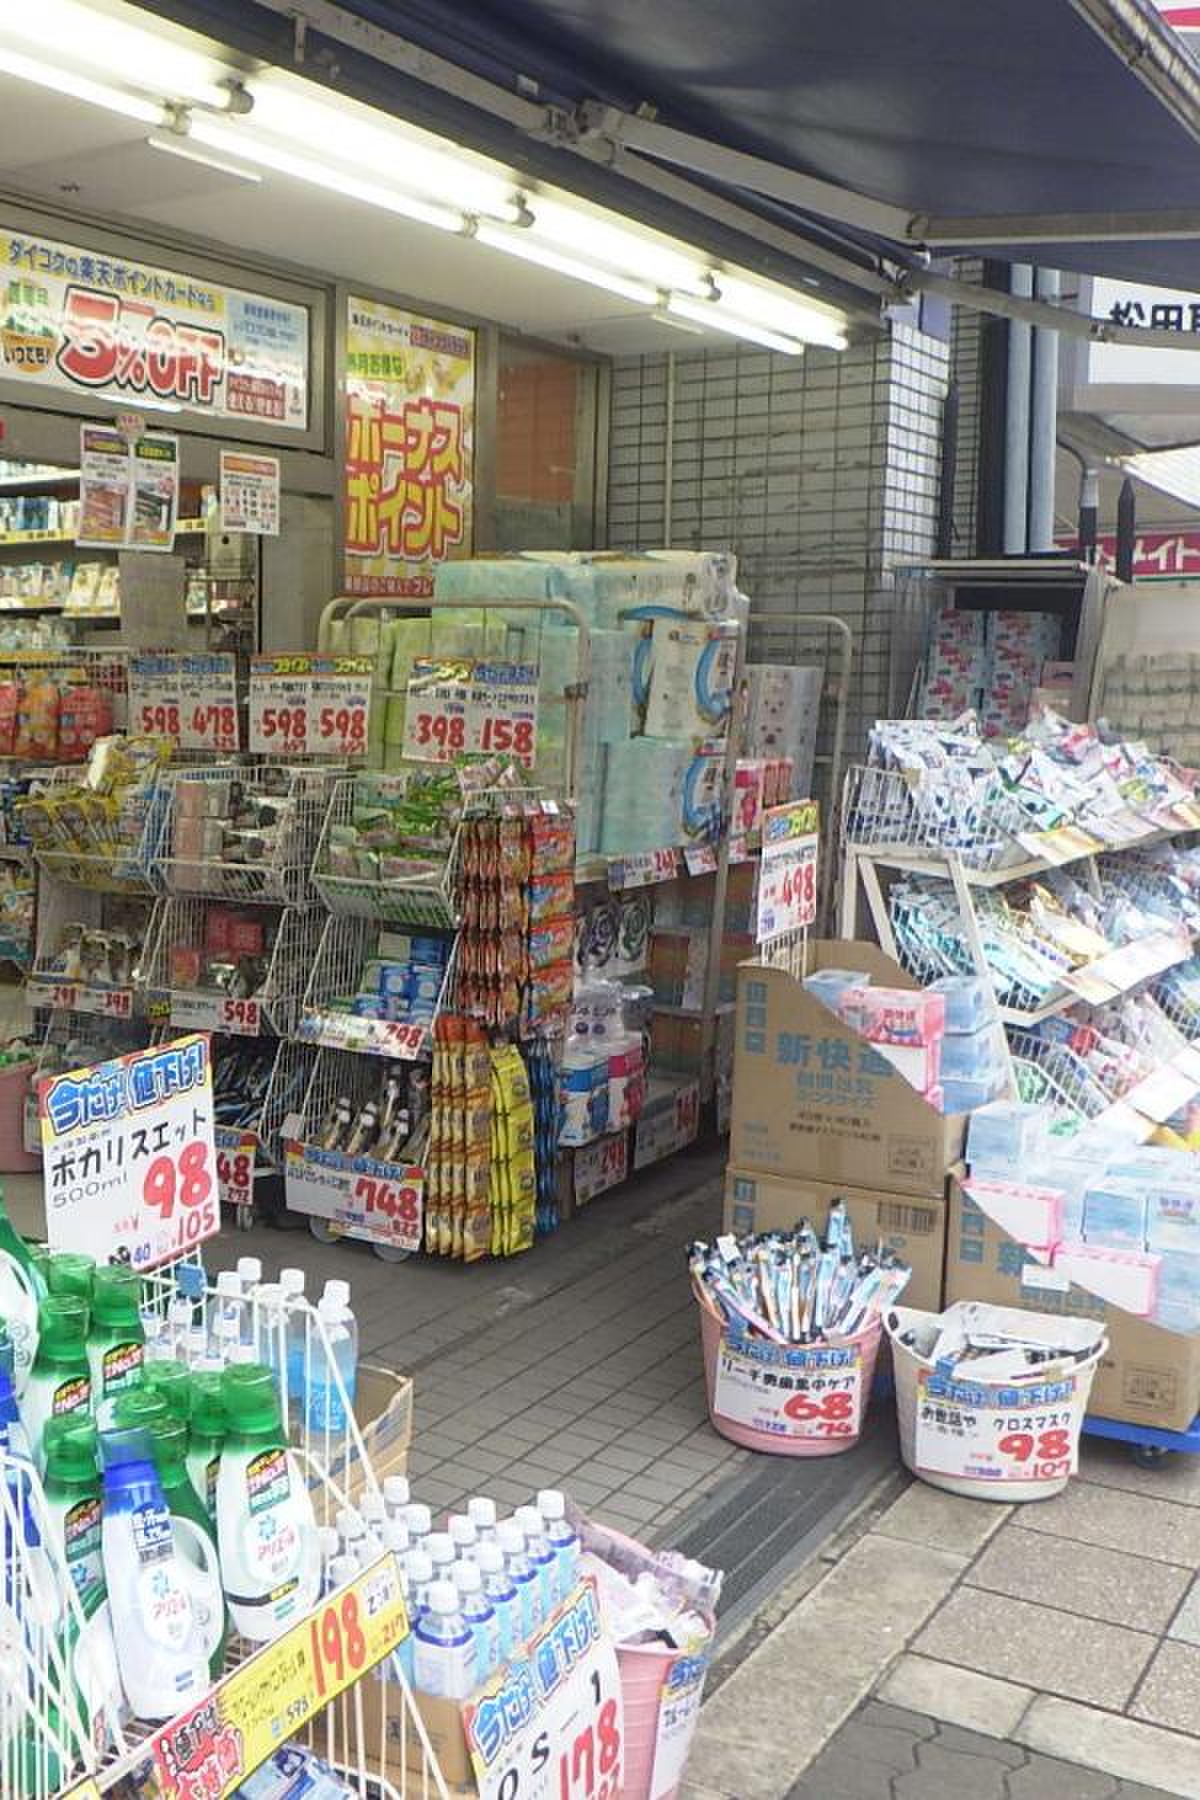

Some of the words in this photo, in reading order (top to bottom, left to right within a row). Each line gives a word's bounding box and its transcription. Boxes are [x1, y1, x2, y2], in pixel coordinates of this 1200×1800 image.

[346, 396, 464, 485] ボーナス
[345, 464, 464, 560] ポイント
[142, 705, 181, 736] 598
[192, 705, 235, 736] 478
[261, 707, 307, 739] 598
[320, 707, 367, 739] 598
[415, 713, 465, 748] 398
[481, 717, 533, 754] 158
[222, 1000, 258, 1026] 598
[49, 1066, 128, 1136] 今だけ
[129, 1040, 206, 1110] 値下げ!
[51, 1107, 207, 1188] ポカリスエット
[53, 1171, 128, 1208] 500ml
[142, 1140, 212, 1220] 98
[355, 1177, 418, 1222] 748
[178, 1203, 215, 1245] 105
[783, 1391, 853, 1421] 68
[993, 1412, 1071, 1432] クロスマスク
[997, 1428, 1071, 1462] 98
[1033, 1460, 1071, 1477] 107
[310, 1591, 368, 1698] 198
